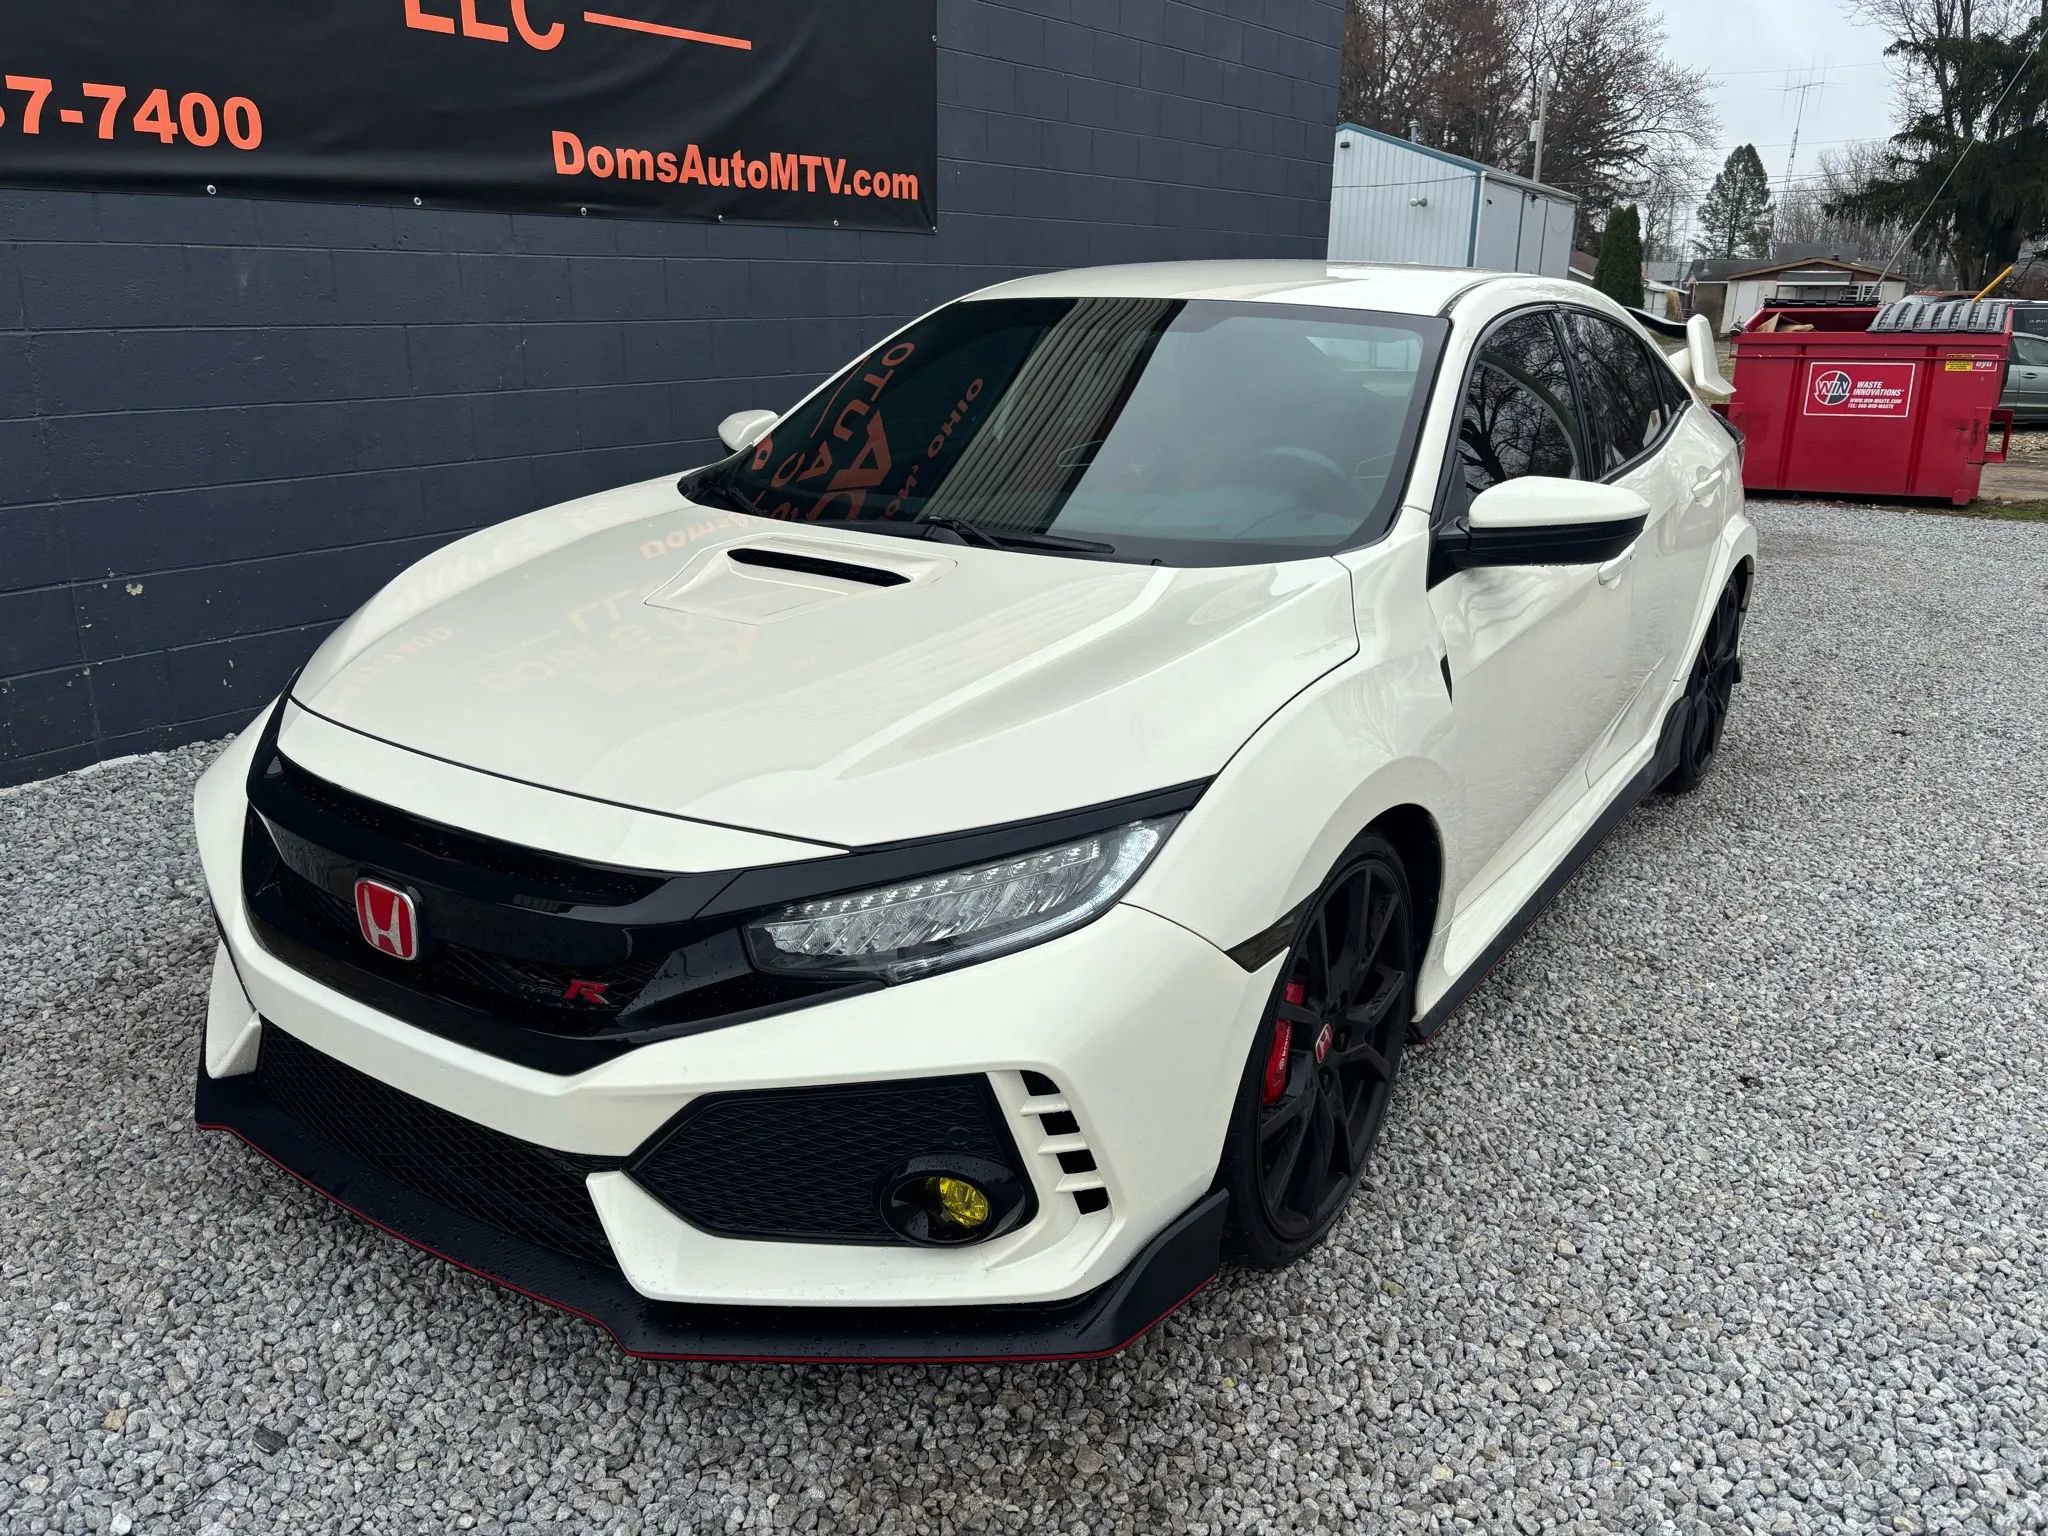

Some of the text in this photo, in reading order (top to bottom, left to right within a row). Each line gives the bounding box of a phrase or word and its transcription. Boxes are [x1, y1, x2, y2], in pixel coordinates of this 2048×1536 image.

[0, 74, 263, 151] 7-7400
[551, 130, 919, 200] DomsAutoMTV.com
[1818, 380, 1849, 396] WIN
[1852, 388, 1903, 397] INNOVATIONS
[1856, 381, 1884, 389] WASTE
[561, 979, 610, 1005] R
